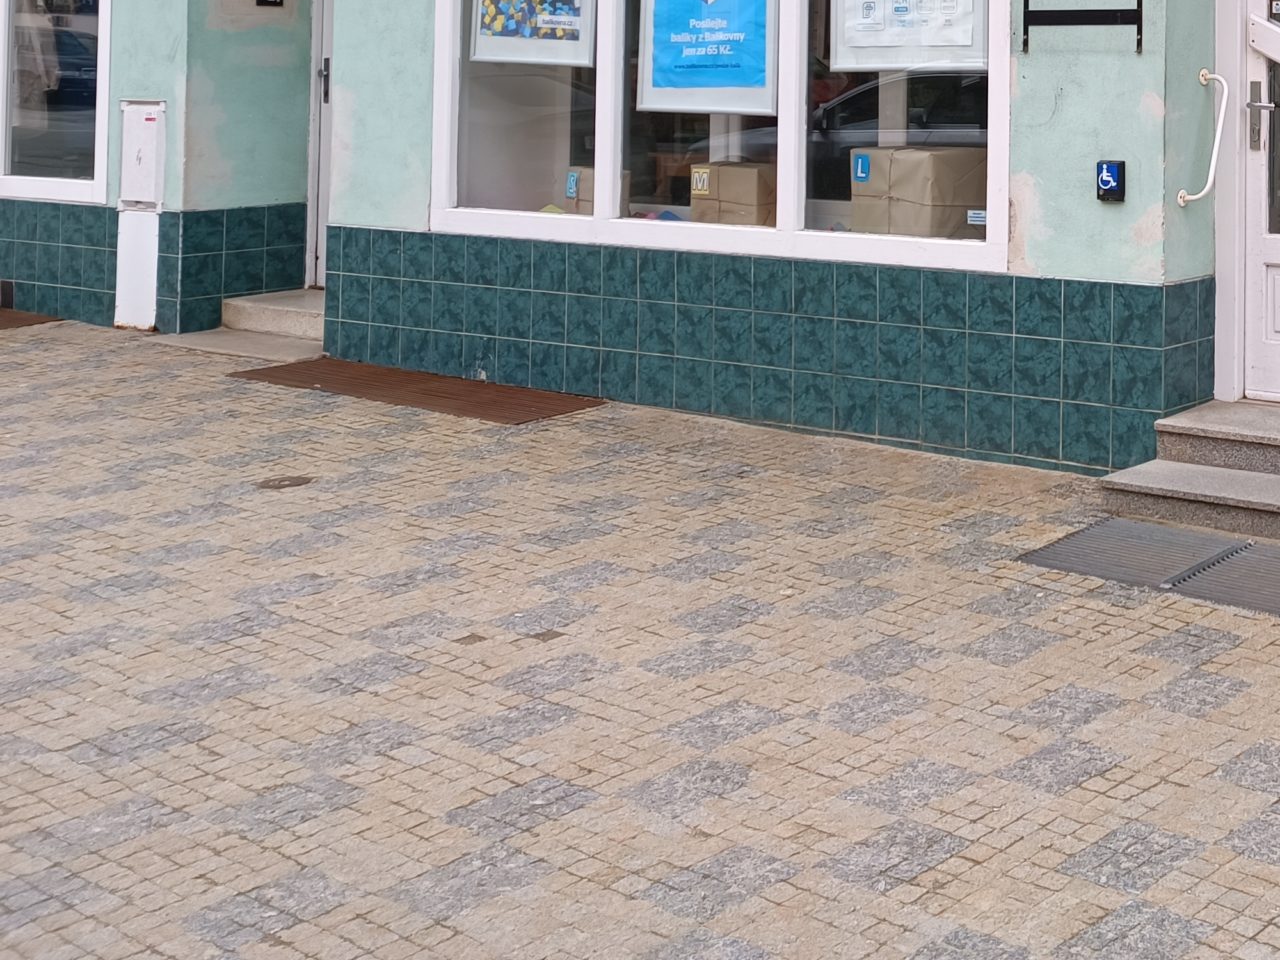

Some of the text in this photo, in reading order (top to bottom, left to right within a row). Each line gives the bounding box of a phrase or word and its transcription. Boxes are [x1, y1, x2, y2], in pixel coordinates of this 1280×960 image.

[706, 44, 718, 55] 65
[856, 158, 866, 177] L
[692, 171, 709, 191] M
